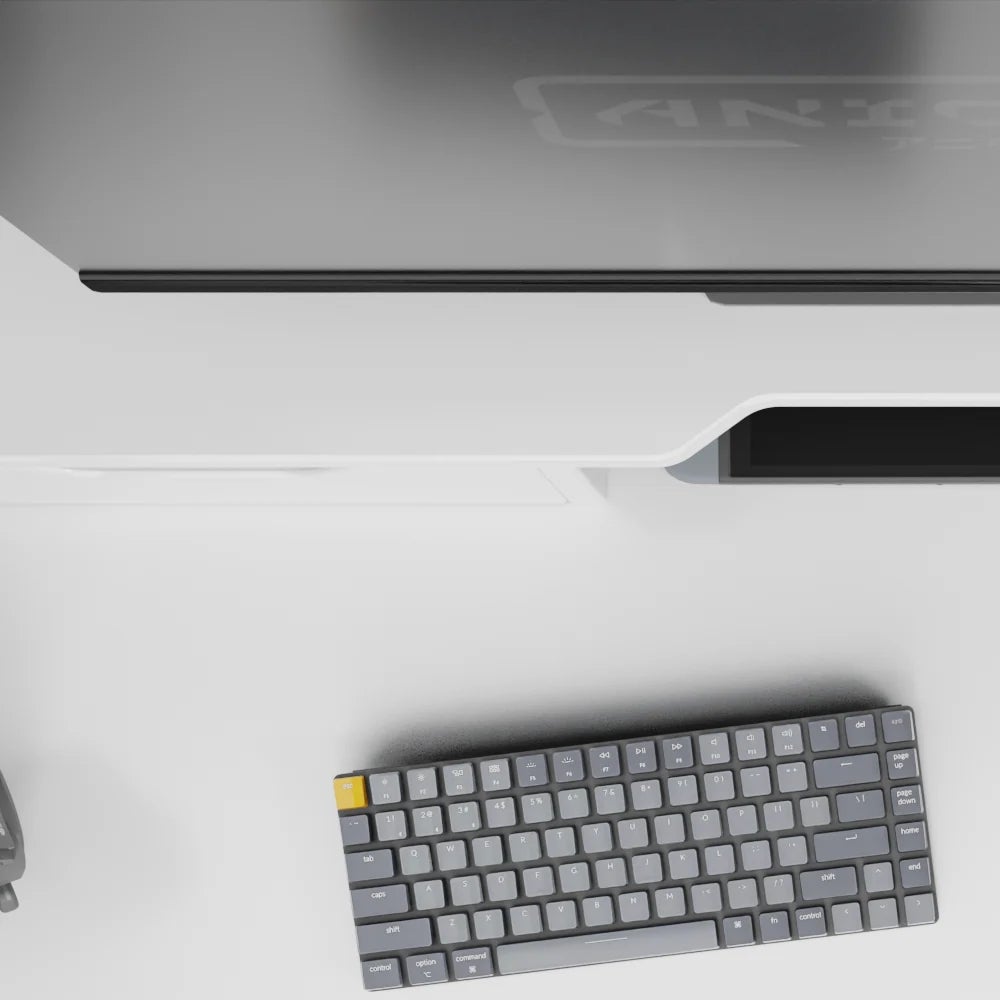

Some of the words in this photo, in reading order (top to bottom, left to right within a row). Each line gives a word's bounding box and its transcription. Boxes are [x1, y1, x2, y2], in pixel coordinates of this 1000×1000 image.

[855, 720, 866, 729] del
[893, 752, 910, 761] page
[896, 789, 913, 797] page
[897, 797, 916, 805] down
[739, 809, 744, 817] P
[702, 814, 709, 822] O
[593, 827, 599, 835] Y
[900, 826, 920, 835] home
[484, 840, 490, 848] E
[520, 836, 527, 844] R
[410, 849, 418, 858] Q
[363, 855, 374, 863] tab
[680, 854, 686, 862] K
[908, 862, 921, 870] end
[570, 867, 578, 875] G
[498, 876, 505, 884] D
[821, 872, 836, 881] shift
[462, 880, 469, 888] S
[370, 891, 386, 900] caps
[666, 892, 674, 900] M
[595, 901, 600, 909] B
[799, 912, 822, 920] control
[385, 925, 401, 934] shift
[455, 952, 487, 962] command
[415, 958, 437, 968] option
[369, 963, 392, 973] control
